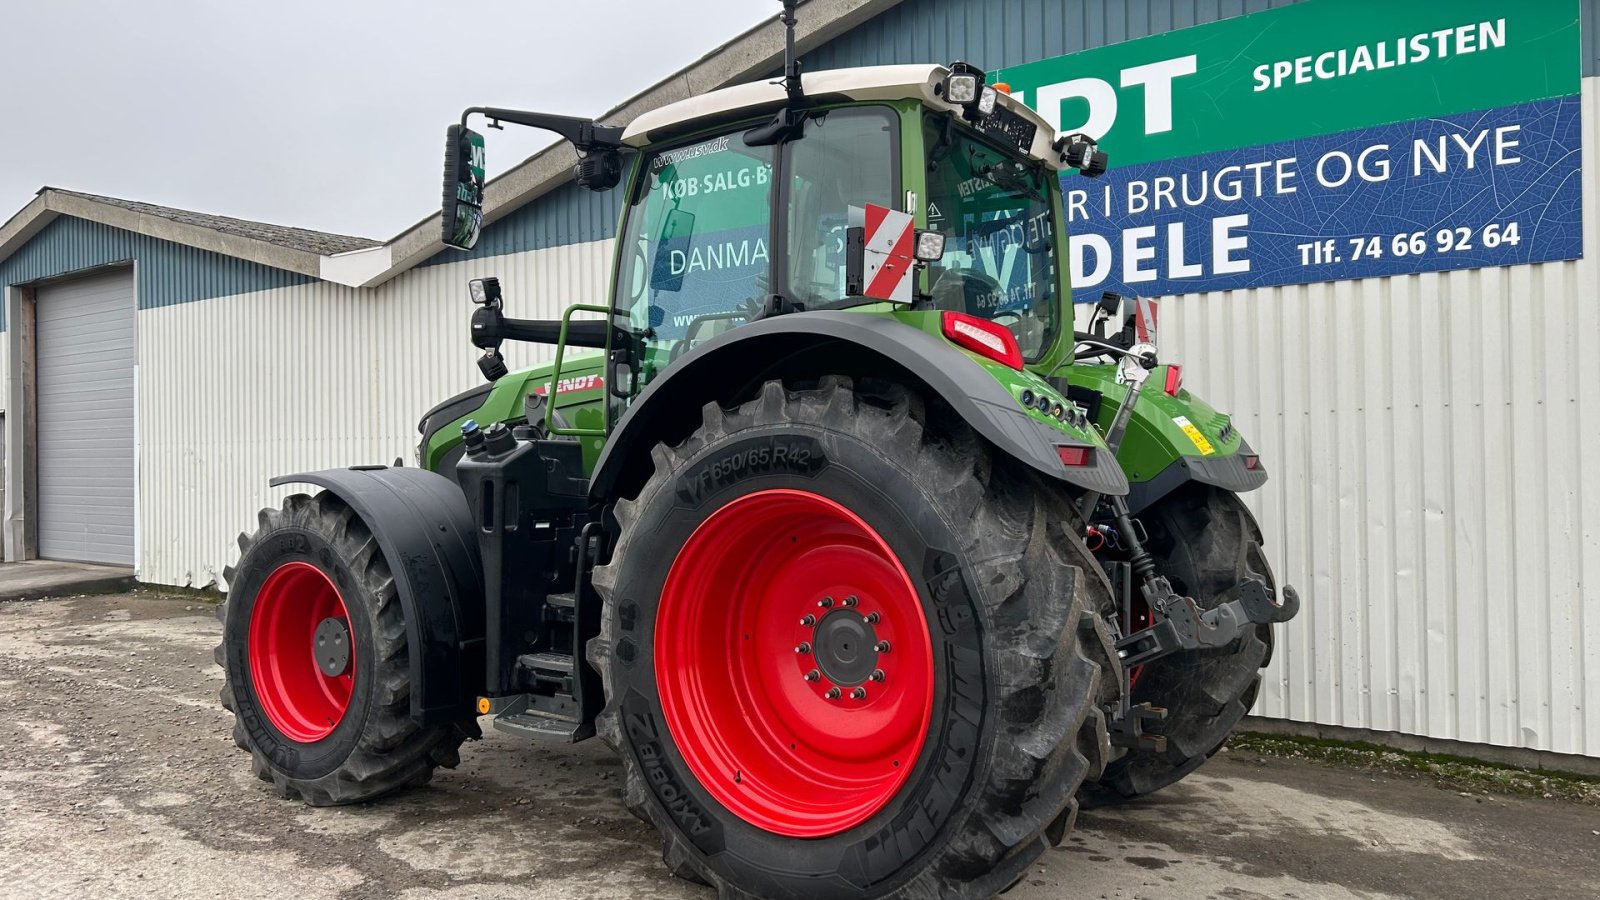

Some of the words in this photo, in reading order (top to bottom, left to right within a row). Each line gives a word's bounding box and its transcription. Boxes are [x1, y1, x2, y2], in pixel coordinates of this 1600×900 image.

[1253, 18, 1506, 92] SPECIALISTEN
[1009, 54, 1197, 148] DT
[1127, 157, 1297, 215] BRUGTE
[1316, 144, 1390, 188] OG
[1413, 125, 1521, 176] NYE
[1297, 239, 1341, 266] Tlf.
[1349, 236, 1383, 261] 74
[1391, 231, 1427, 256] 66
[1436, 227, 1472, 252] 92
[1482, 222, 1521, 248] 64
[712, 447, 770, 480] 650/65
[772, 446, 811, 465] R42
